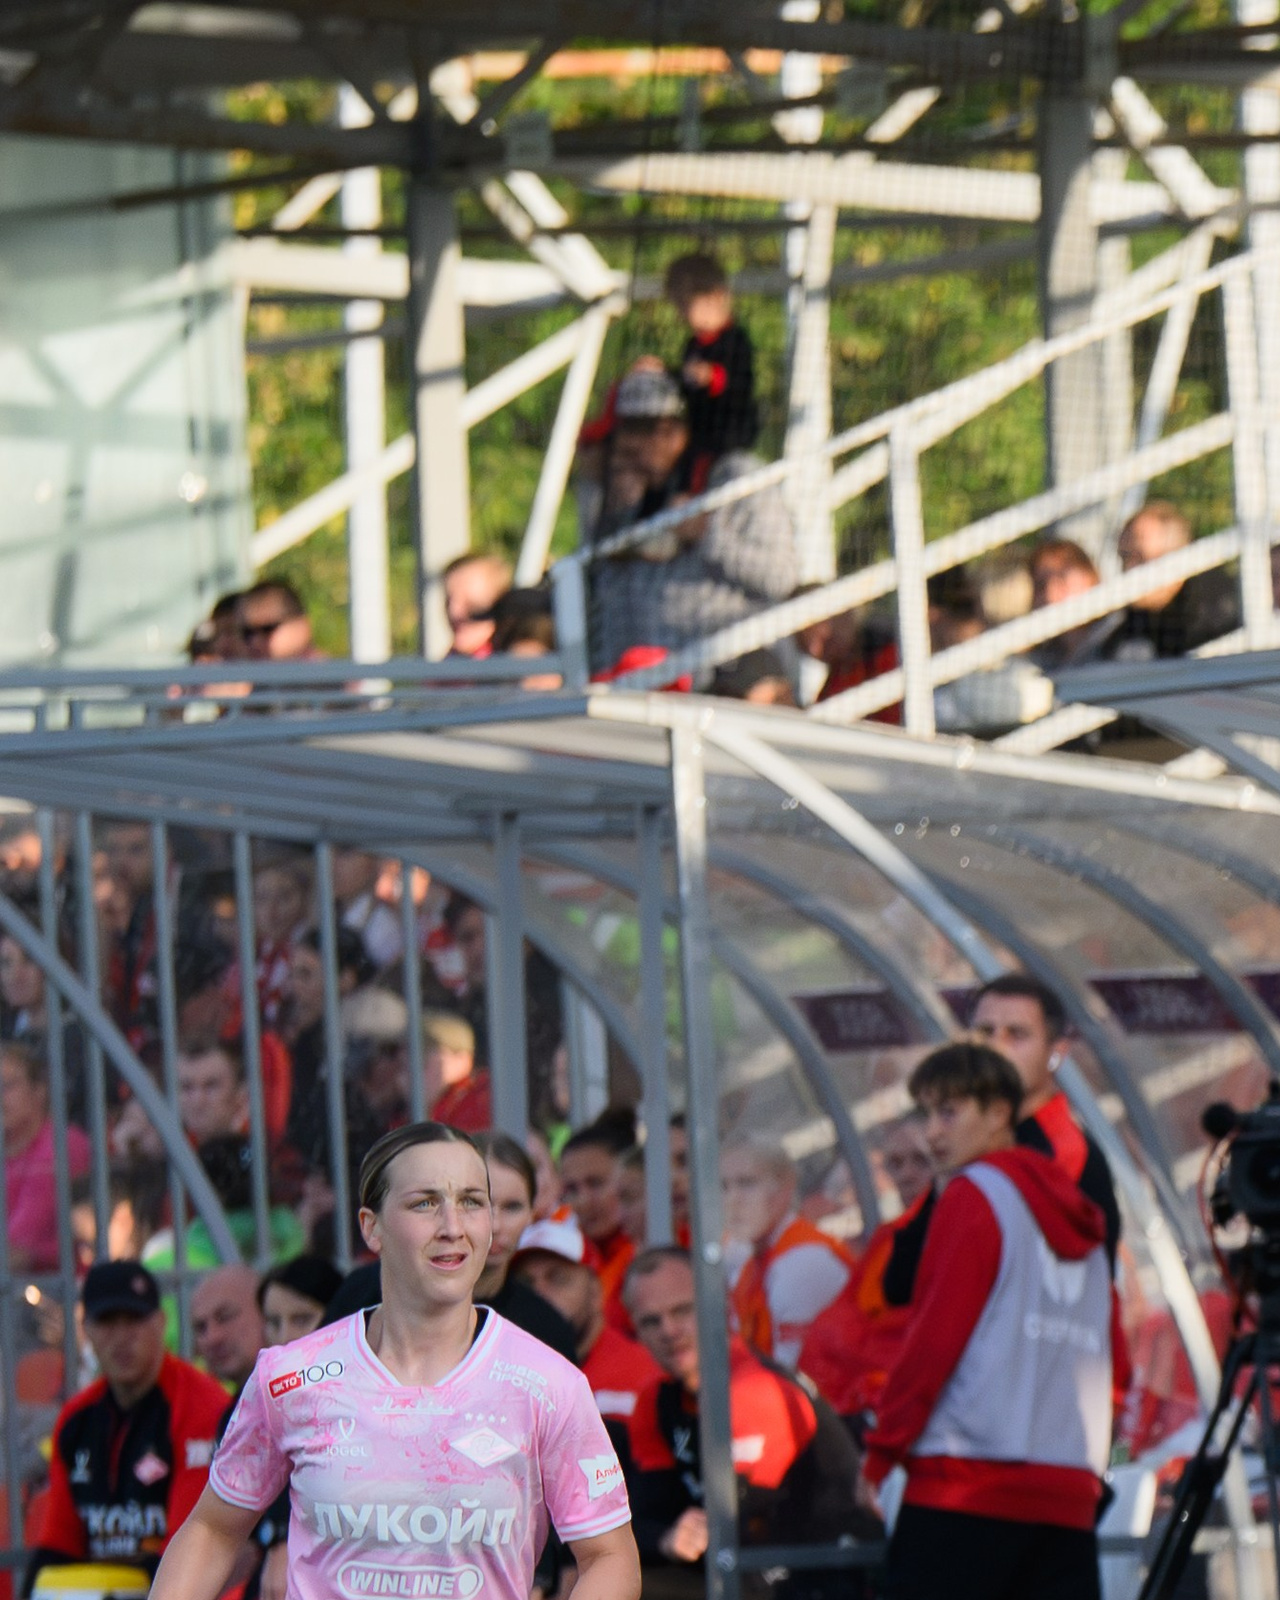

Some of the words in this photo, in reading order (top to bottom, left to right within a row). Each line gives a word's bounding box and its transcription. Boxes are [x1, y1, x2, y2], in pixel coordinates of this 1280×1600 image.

[493, 1359, 548, 1388] КИБЕР
[314, 1498, 517, 1547] ЛУКОЙЛ
[350, 1569, 456, 1597] WINLINE
